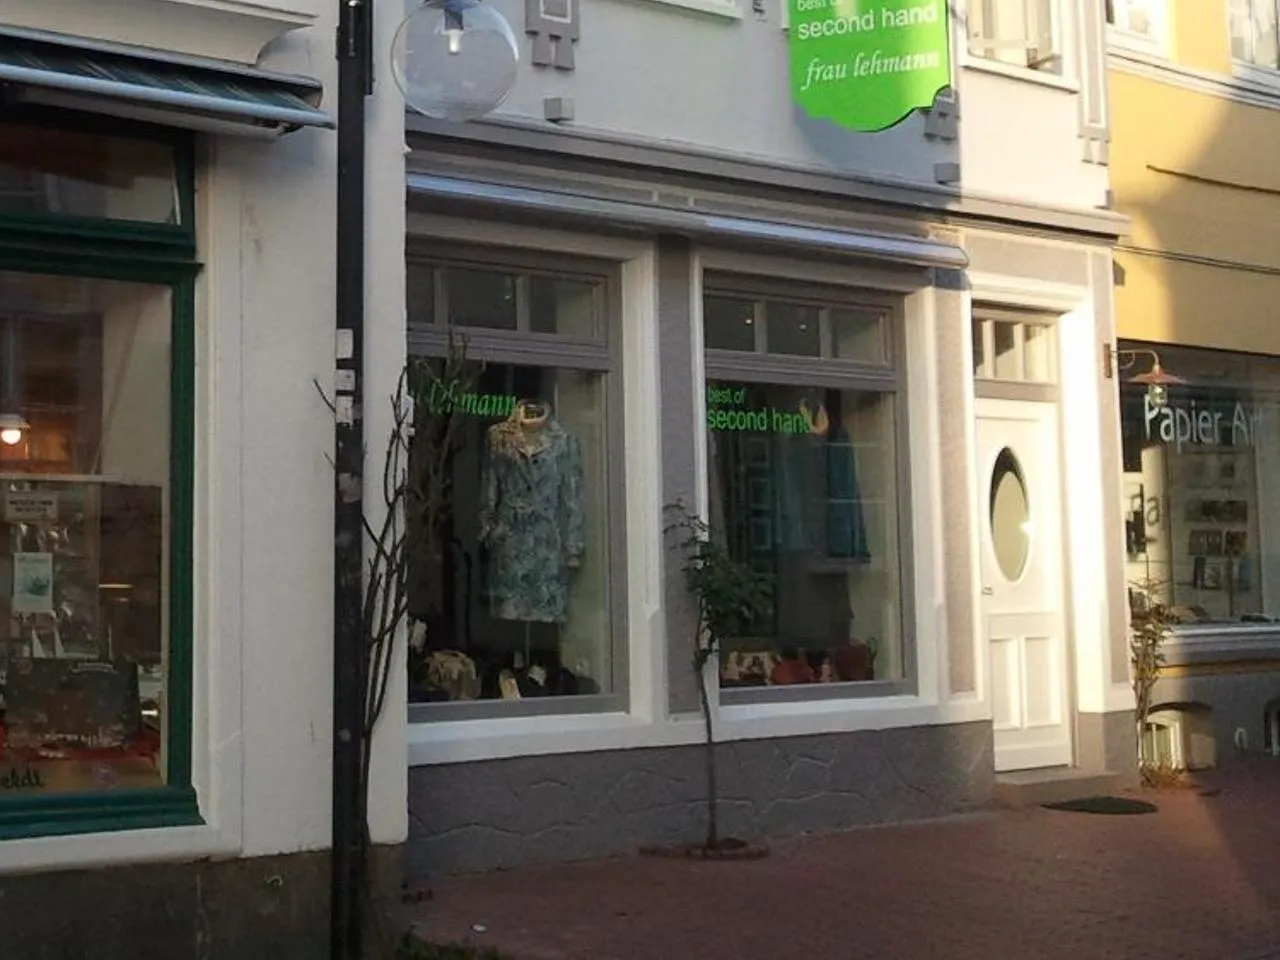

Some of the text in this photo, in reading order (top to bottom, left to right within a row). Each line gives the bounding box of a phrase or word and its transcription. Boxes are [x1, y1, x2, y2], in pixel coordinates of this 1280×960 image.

[797, 0, 938, 40] second hand
[800, 50, 940, 91] frau lehmann
[707, 385, 748, 404] best of
[707, 407, 767, 431] second
[1143, 394, 1223, 454] Papier
